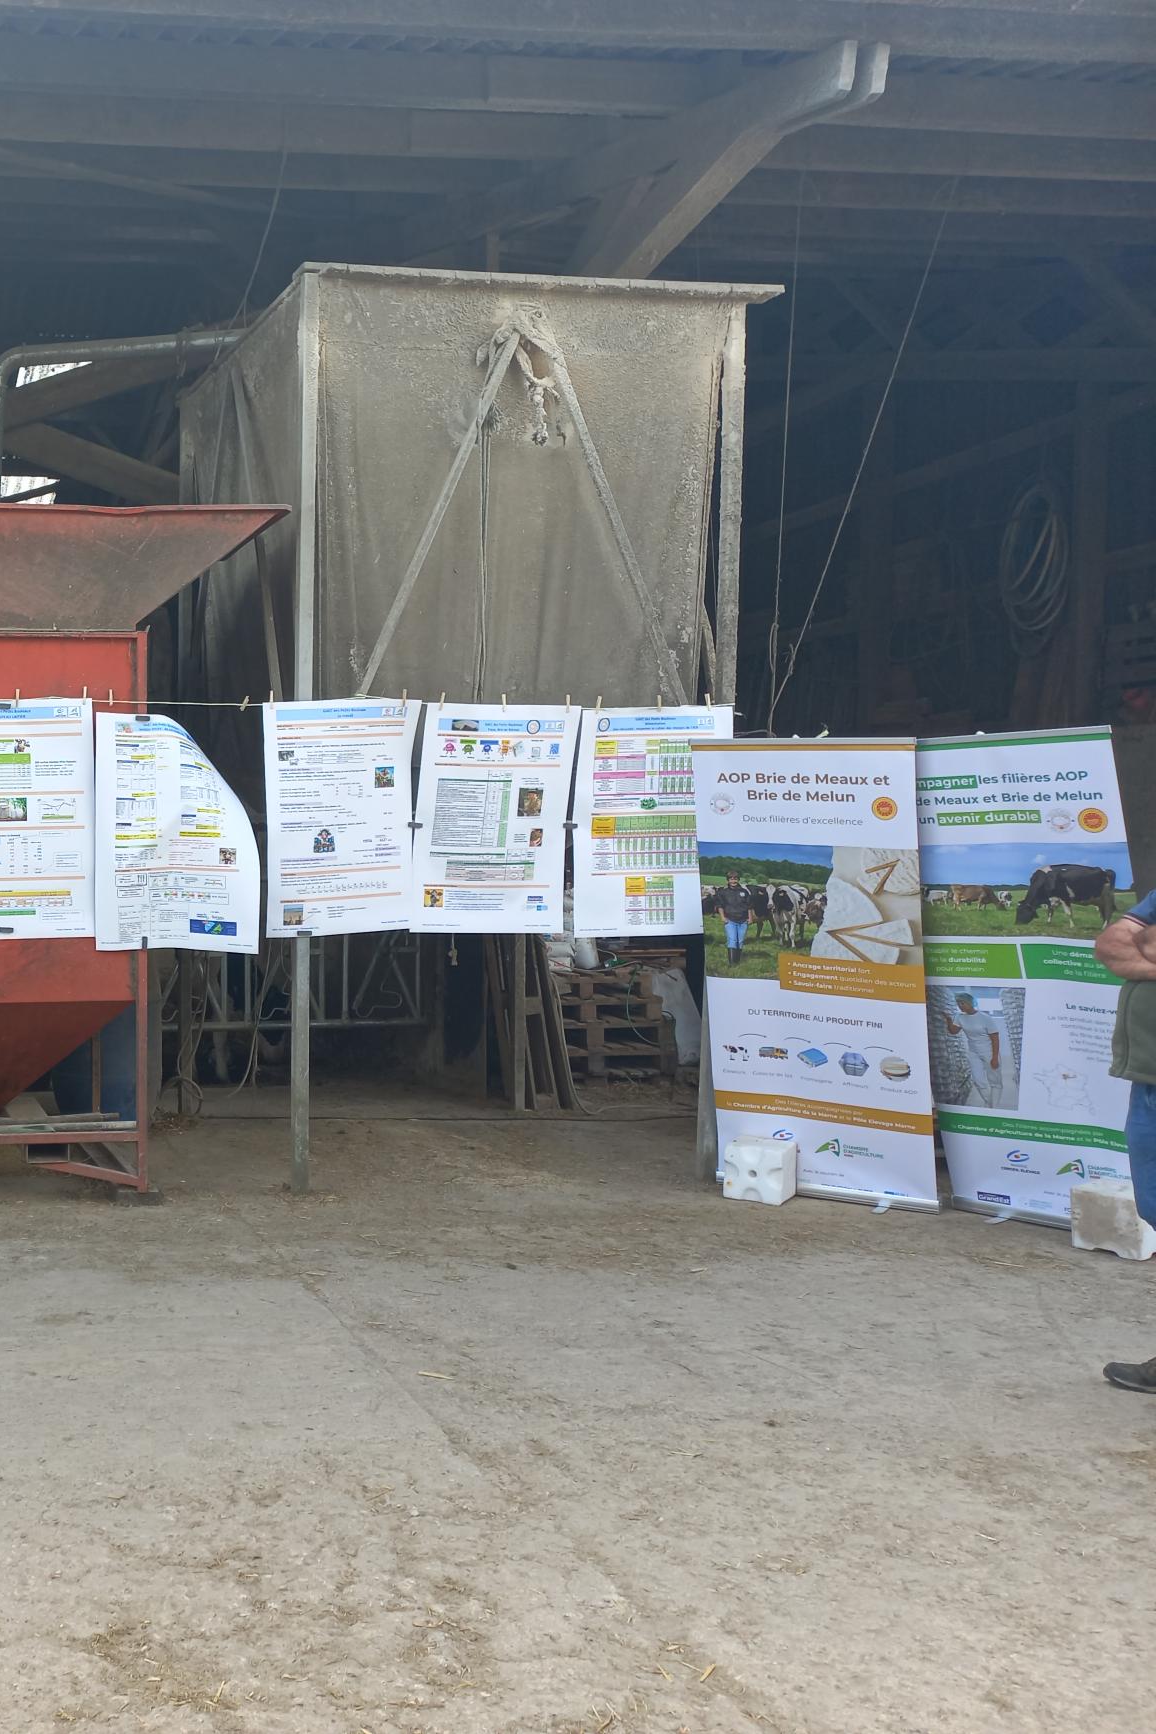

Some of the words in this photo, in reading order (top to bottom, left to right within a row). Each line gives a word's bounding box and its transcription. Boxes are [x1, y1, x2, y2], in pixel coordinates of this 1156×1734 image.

[716, 772, 751, 784] AOP
[755, 772, 787, 785] Brie
[790, 773, 811, 785] de
[815, 774, 869, 786] Meaux
[873, 775, 890, 786] et
[978, 773, 998, 785] les
[1001, 771, 1051, 784] filières
[1054, 770, 1089, 782] AOP
[747, 789, 778, 802] Brie
[782, 790, 802, 802] de
[806, 791, 856, 803] Melun
[934, 794, 979, 806] Meaux
[982, 793, 997, 804] et
[1001, 791, 1029, 803] Brie
[1033, 791, 1051, 802] de
[1055, 789, 1103, 801] Melun
[742, 814, 768, 824] Deux
[769, 815, 801, 825] filières
[802, 816, 864, 827] d'excellence
[919, 815, 936, 825] un
[938, 811, 980, 824] avenir
[984, 810, 1039, 823] durable
[792, 961, 822, 970] Ancrage
[823, 964, 858, 974] territorial
[858, 967, 872, 975] fort
[1043, 958, 1082, 967] collective
[792, 970, 838, 981] Engagement
[874, 977, 888, 986] des
[793, 980, 833, 990] Savoir-faire
[748, 1008, 761, 1016] DU
[762, 1009, 811, 1021] TERRITOIRE
[813, 1015, 824, 1023] AU
[826, 1016, 864, 1028] PRODUIT
[866, 1020, 883, 1029] FINI
[732, 1101, 761, 1110] Chambre
[957, 1123, 988, 1132] Chambre
